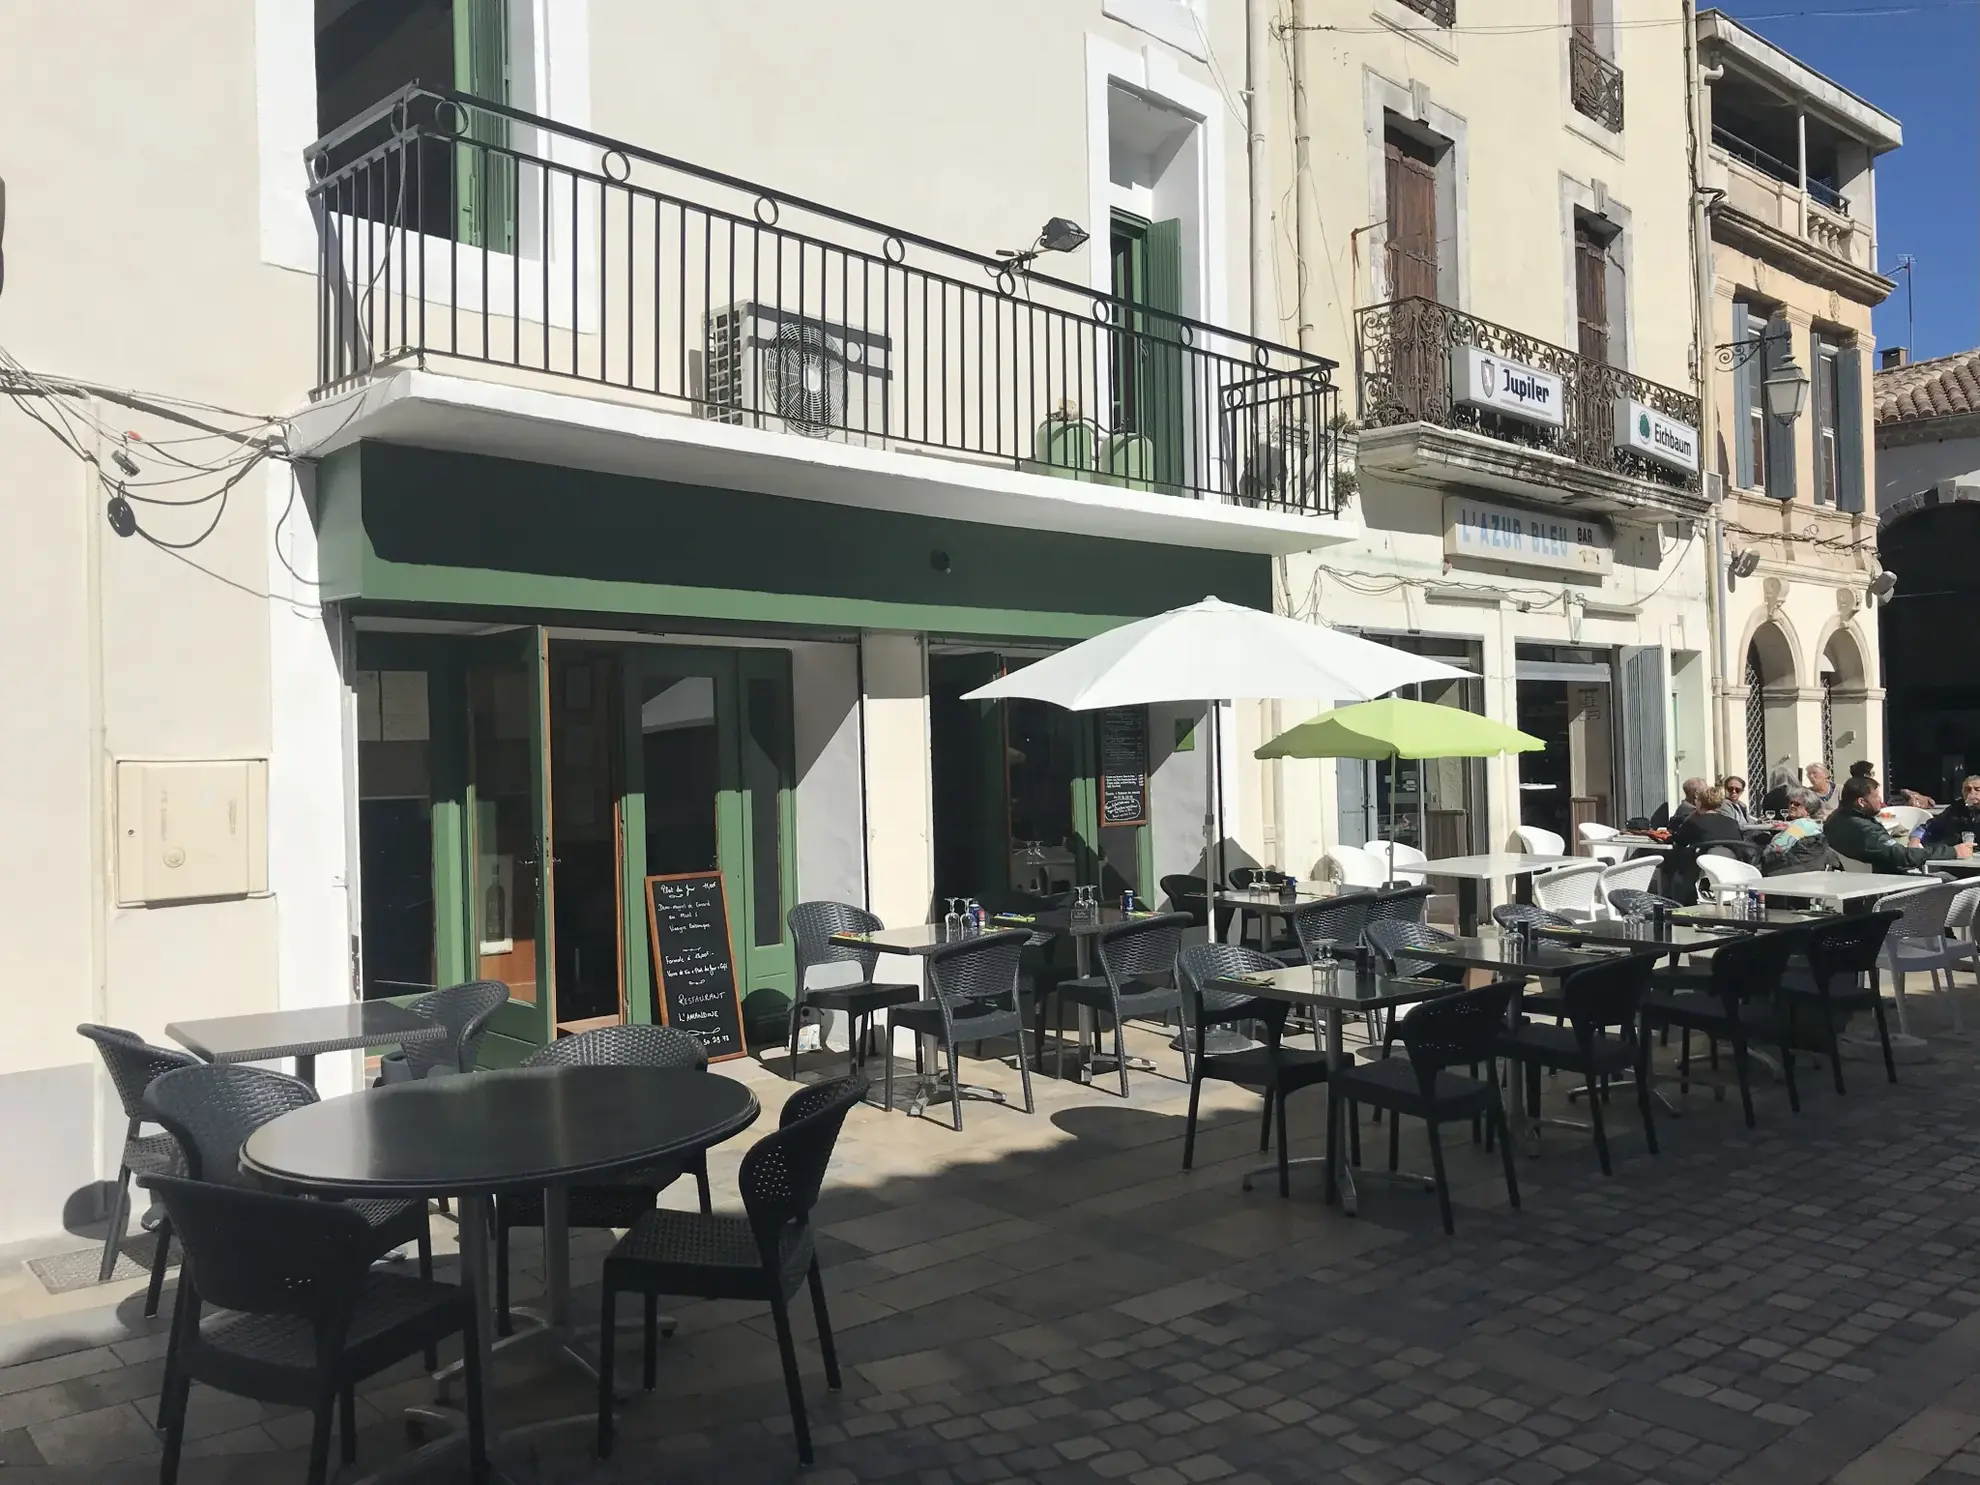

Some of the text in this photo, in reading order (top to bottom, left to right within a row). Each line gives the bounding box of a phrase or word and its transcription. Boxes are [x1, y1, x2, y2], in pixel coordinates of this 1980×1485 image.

[1502, 368, 1550, 403] Jupiler
[1654, 422, 1692, 457] Eichbaum
[1462, 509, 1593, 557] L'AZUR BLEU BAR
[678, 992, 725, 1005] RESTAURANT
[678, 1011, 719, 1021] L'AMANDINE
